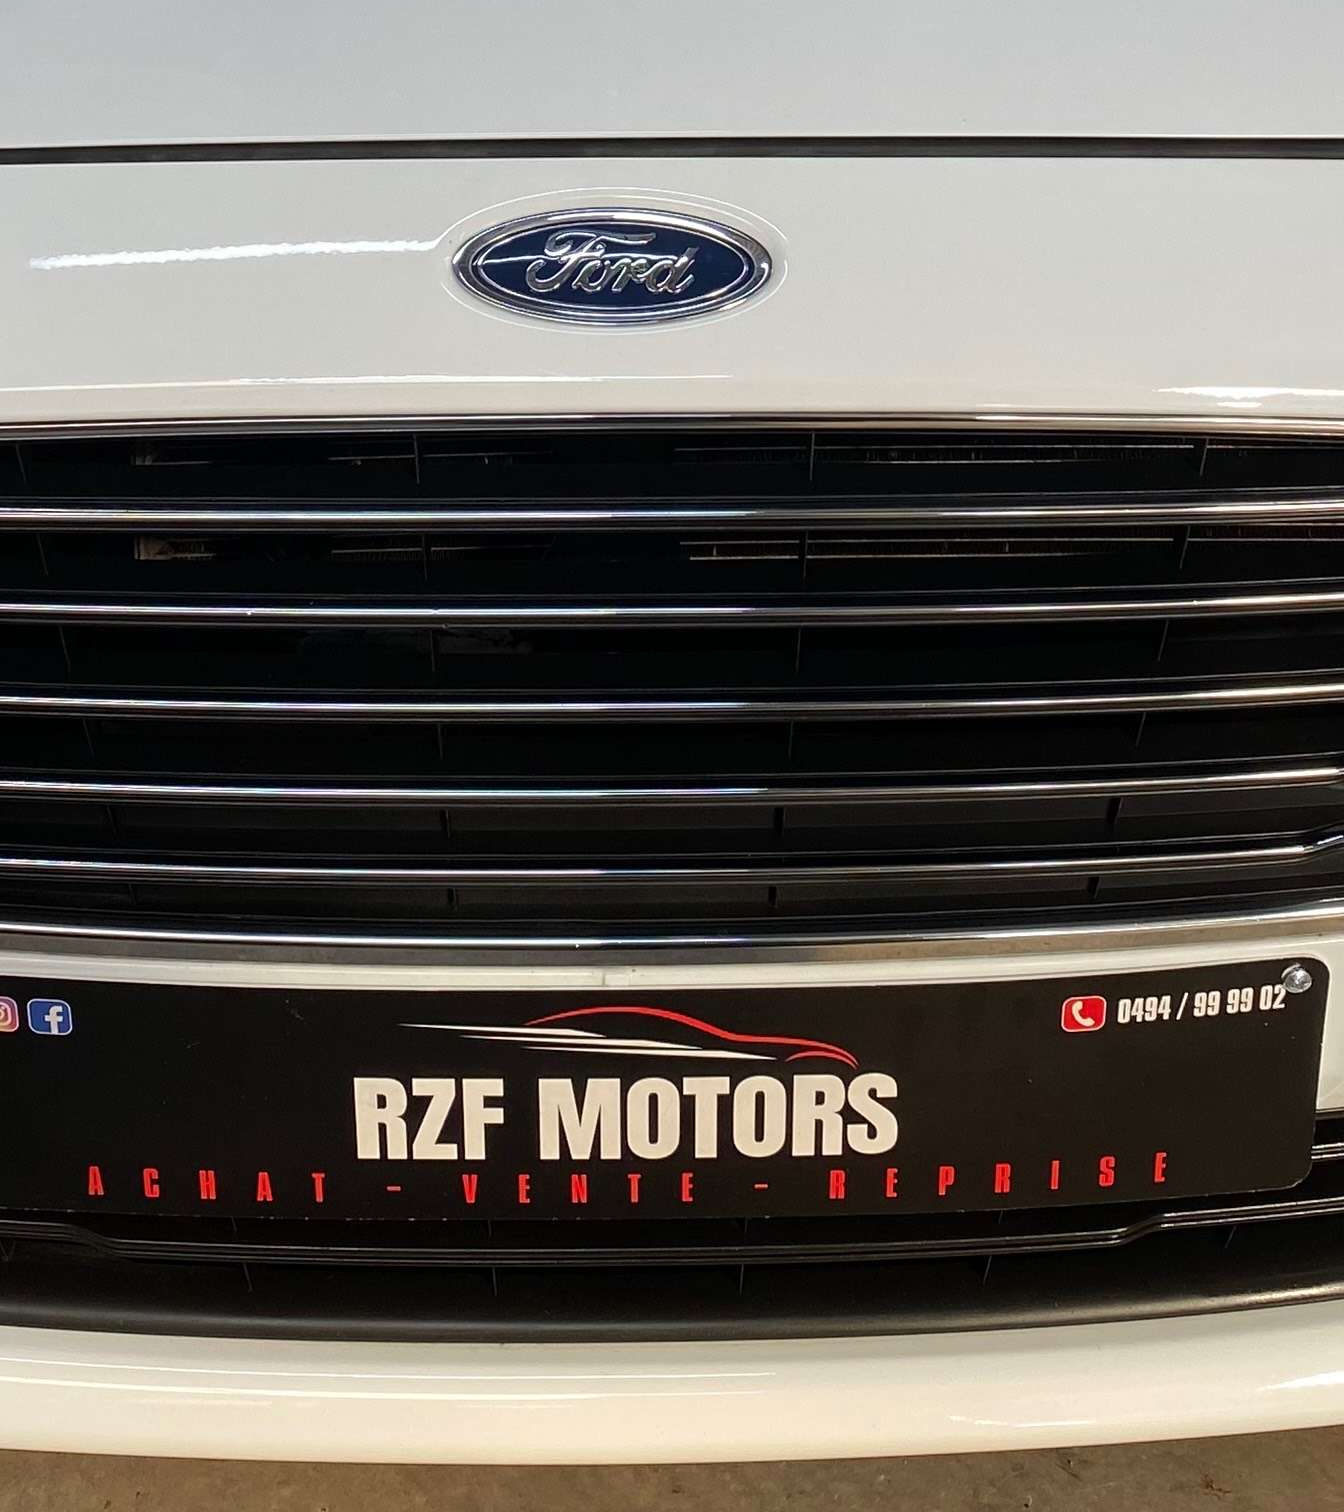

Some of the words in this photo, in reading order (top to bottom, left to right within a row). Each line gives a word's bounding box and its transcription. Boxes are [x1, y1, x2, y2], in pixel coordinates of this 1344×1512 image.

[498, 230, 699, 295] Ford
[1117, 995, 1172, 1024] 0494
[1175, 991, 1190, 1021] /
[1192, 990, 1222, 1018] 99
[1225, 987, 1255, 1015] 99
[1258, 984, 1287, 1011] 02
[353, 1077, 505, 1160] RZF
[538, 1072, 899, 1160] MOTORS
[87, 1164, 325, 1203] ACHAT
[461, 1171, 694, 1205] VENTE
[828, 1151, 1168, 1200] REPRISE
